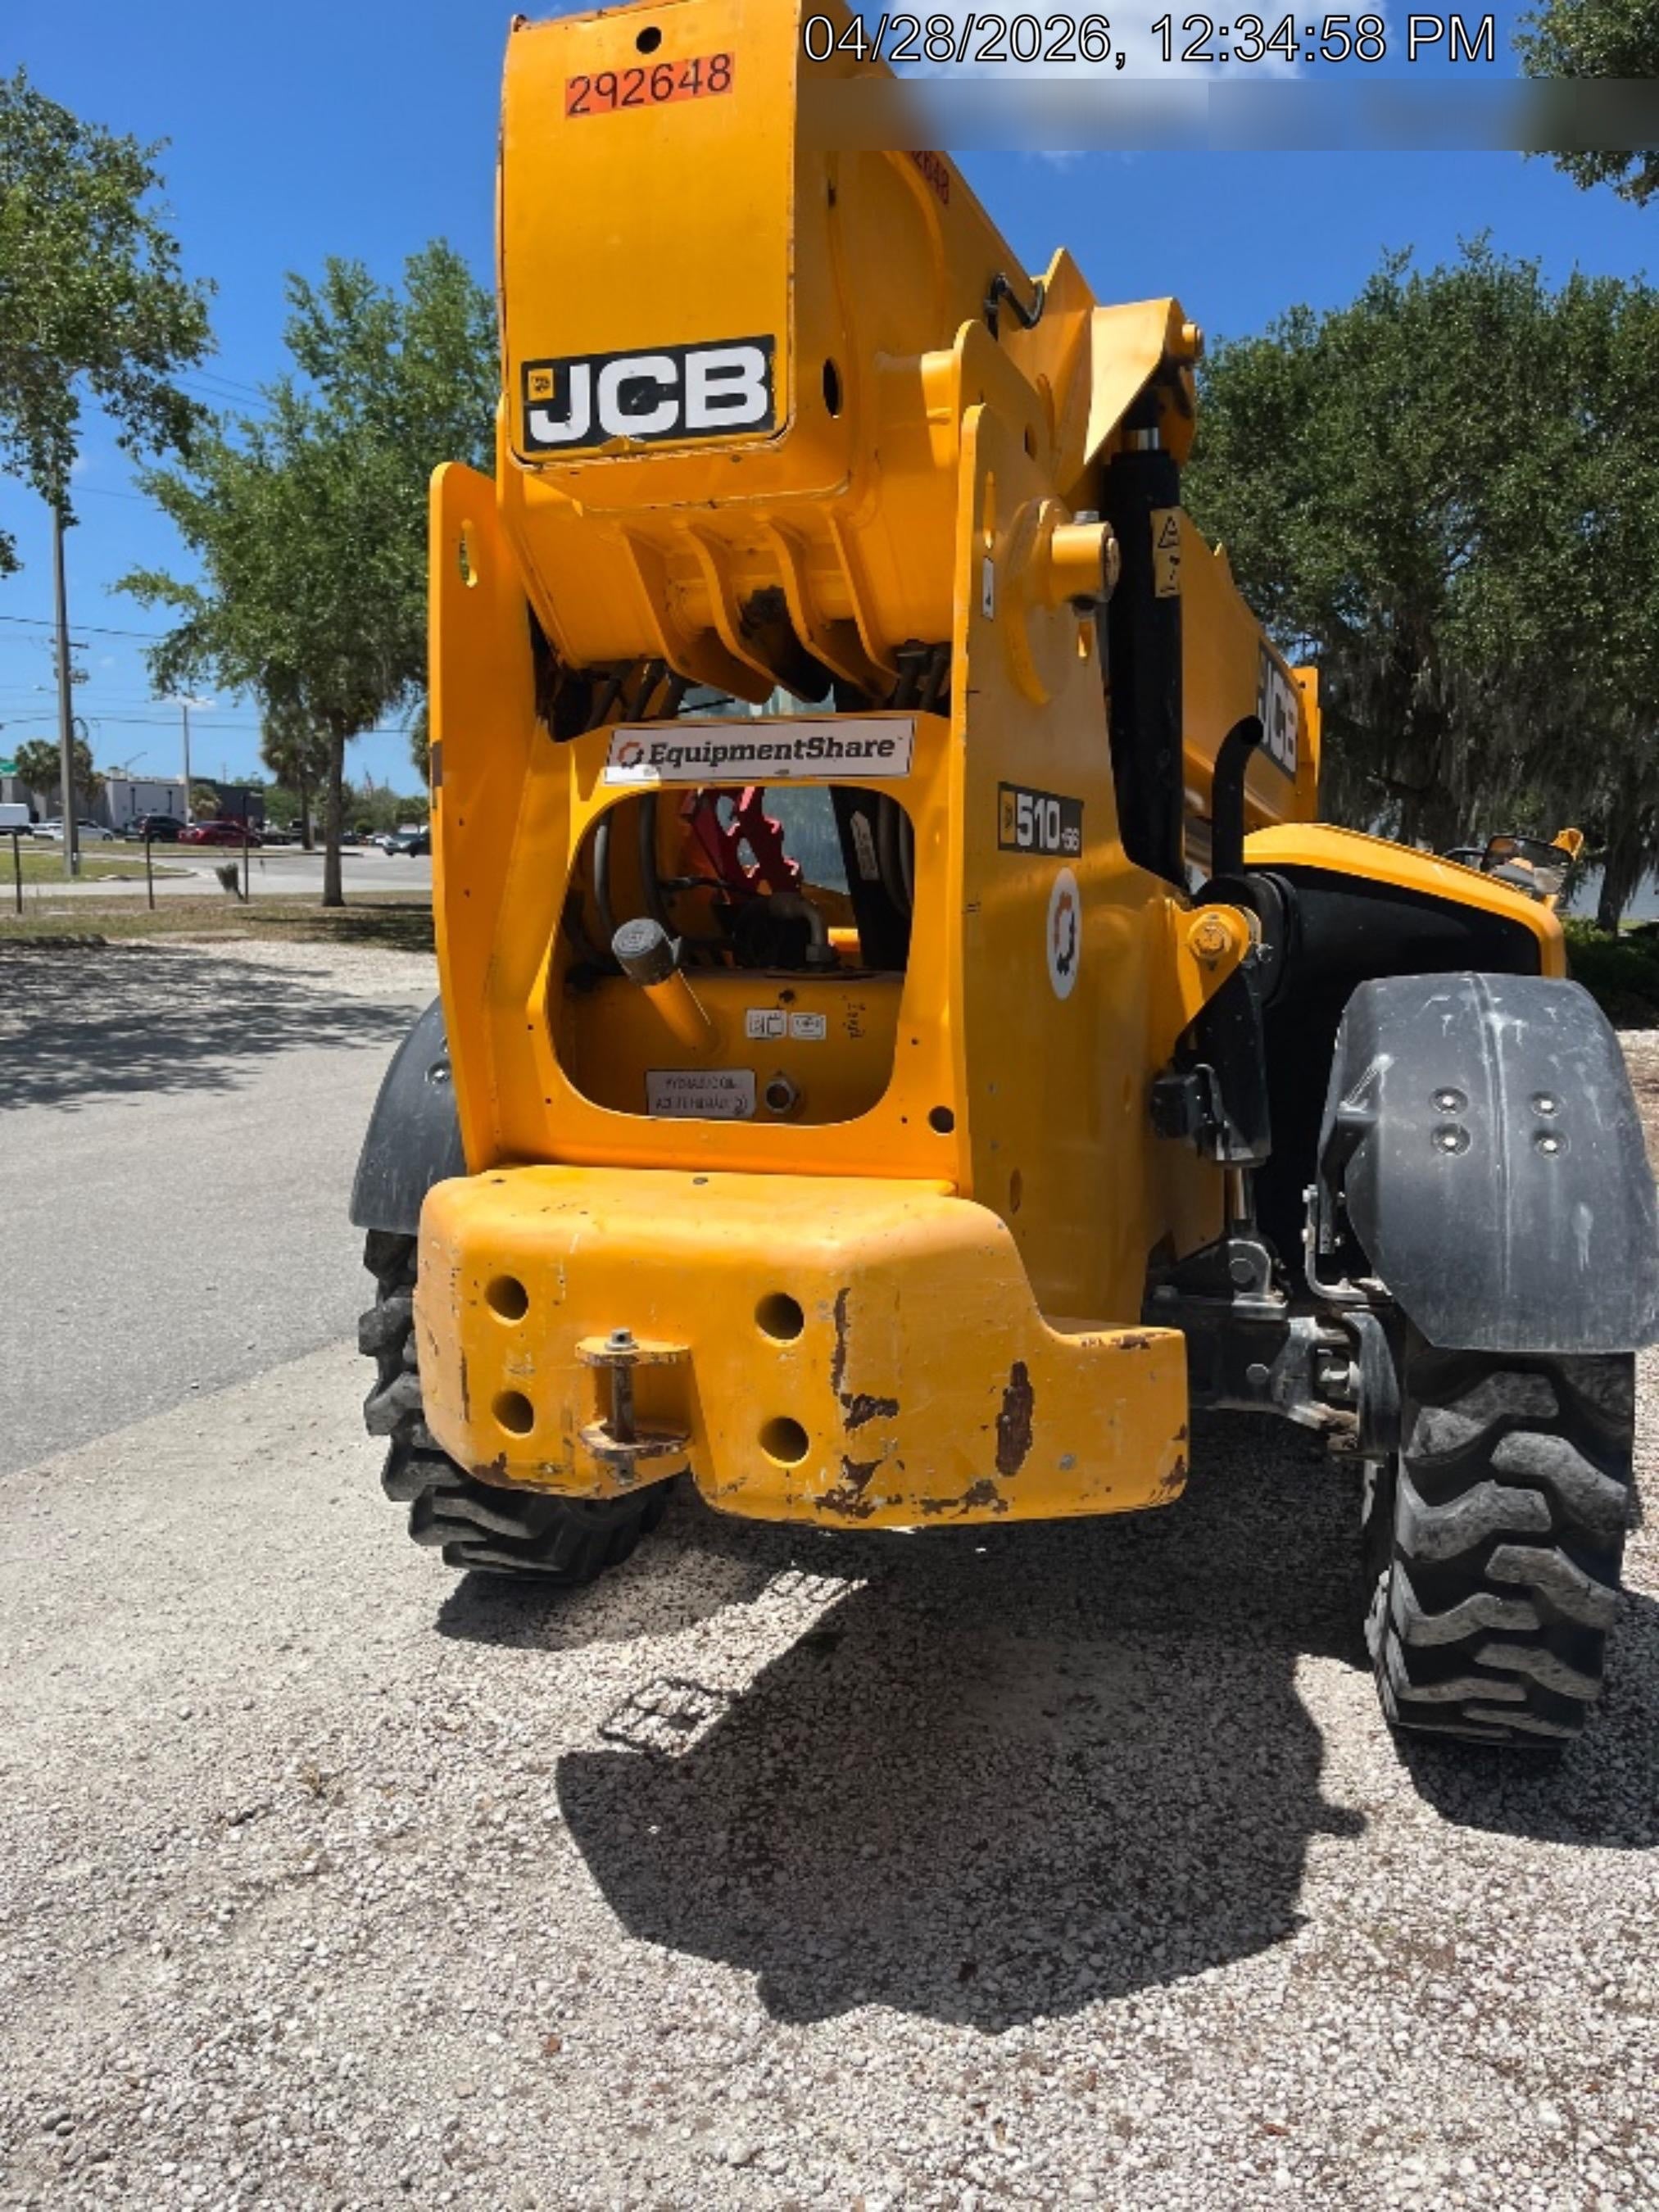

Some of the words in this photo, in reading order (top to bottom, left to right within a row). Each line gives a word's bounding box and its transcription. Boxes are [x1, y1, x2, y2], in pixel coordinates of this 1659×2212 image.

[569, 53, 732, 116] 292648
[529, 346, 768, 442] JCB
[648, 737, 895, 768] EquipmentShare
